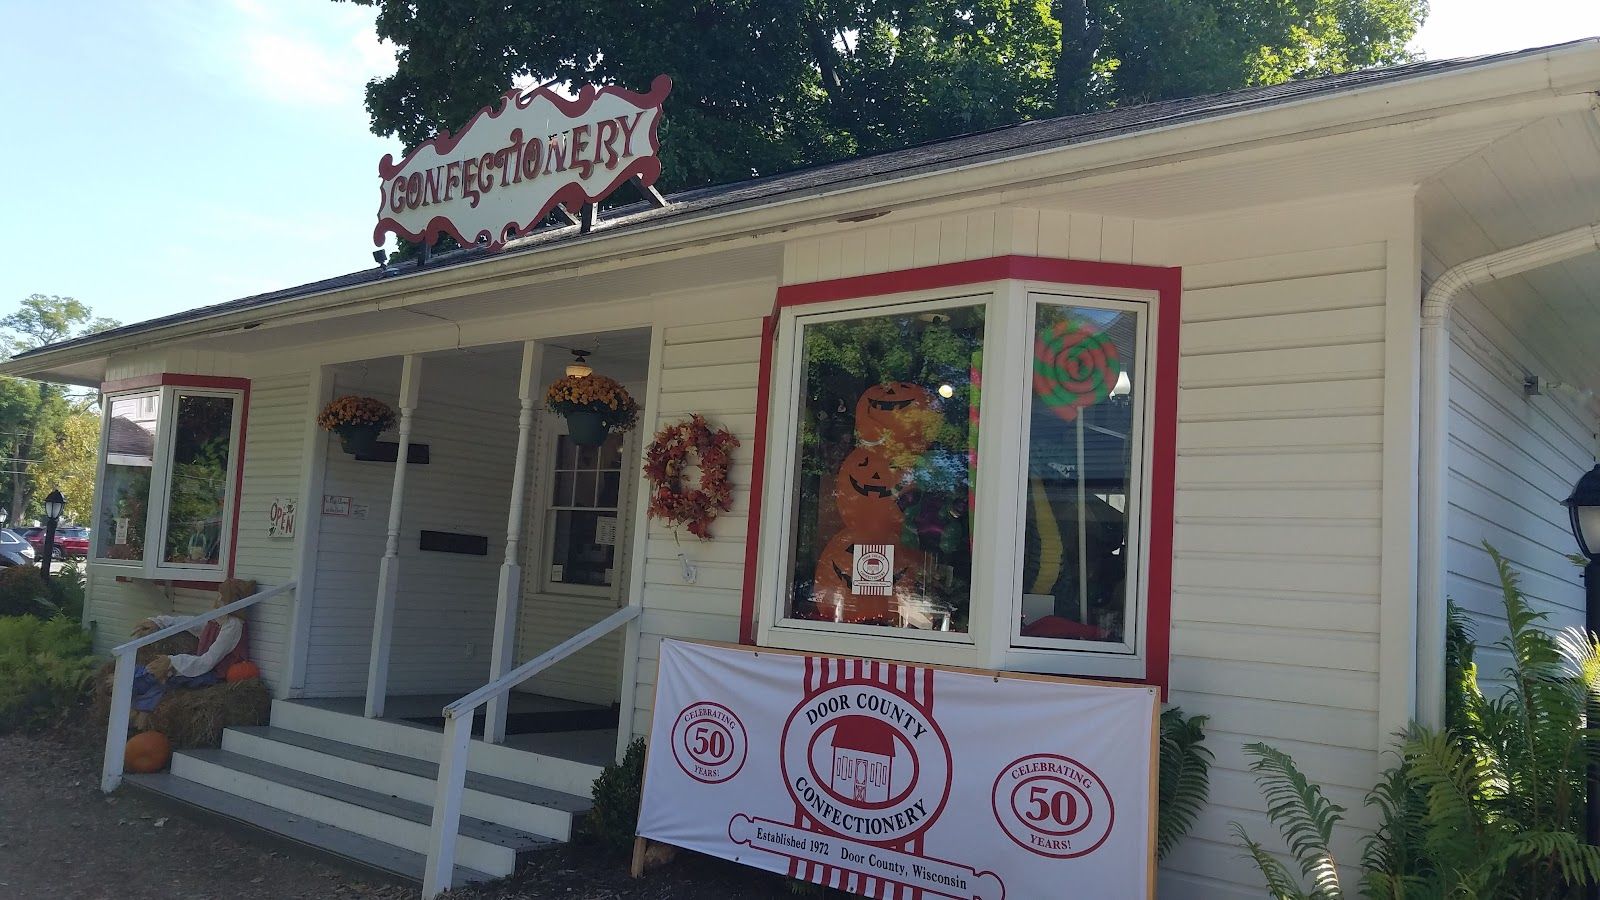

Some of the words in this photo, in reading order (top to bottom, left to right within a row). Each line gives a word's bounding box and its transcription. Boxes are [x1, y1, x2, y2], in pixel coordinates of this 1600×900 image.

[391, 110, 647, 214] CONFECTIONERY
[270, 502, 294, 534] OPEN
[684, 708, 736, 730] CELEBRATING
[805, 693, 851, 725] DOOR
[856, 692, 928, 740] COUNTY
[692, 727, 725, 758] 50
[694, 764, 720, 777] YEARS!
[1011, 762, 1092, 789] CELEBRATING
[795, 776, 928, 835] CONFECTIONERY
[1025, 786, 1077, 826] 50
[1030, 834, 1071, 850] YEARS!
[756, 827, 806, 850] Established
[809, 840, 829, 856] 1972
[841, 847, 865, 864] Door
[868, 853, 909, 876] County,
[912, 864, 967, 890] Wisconsin
